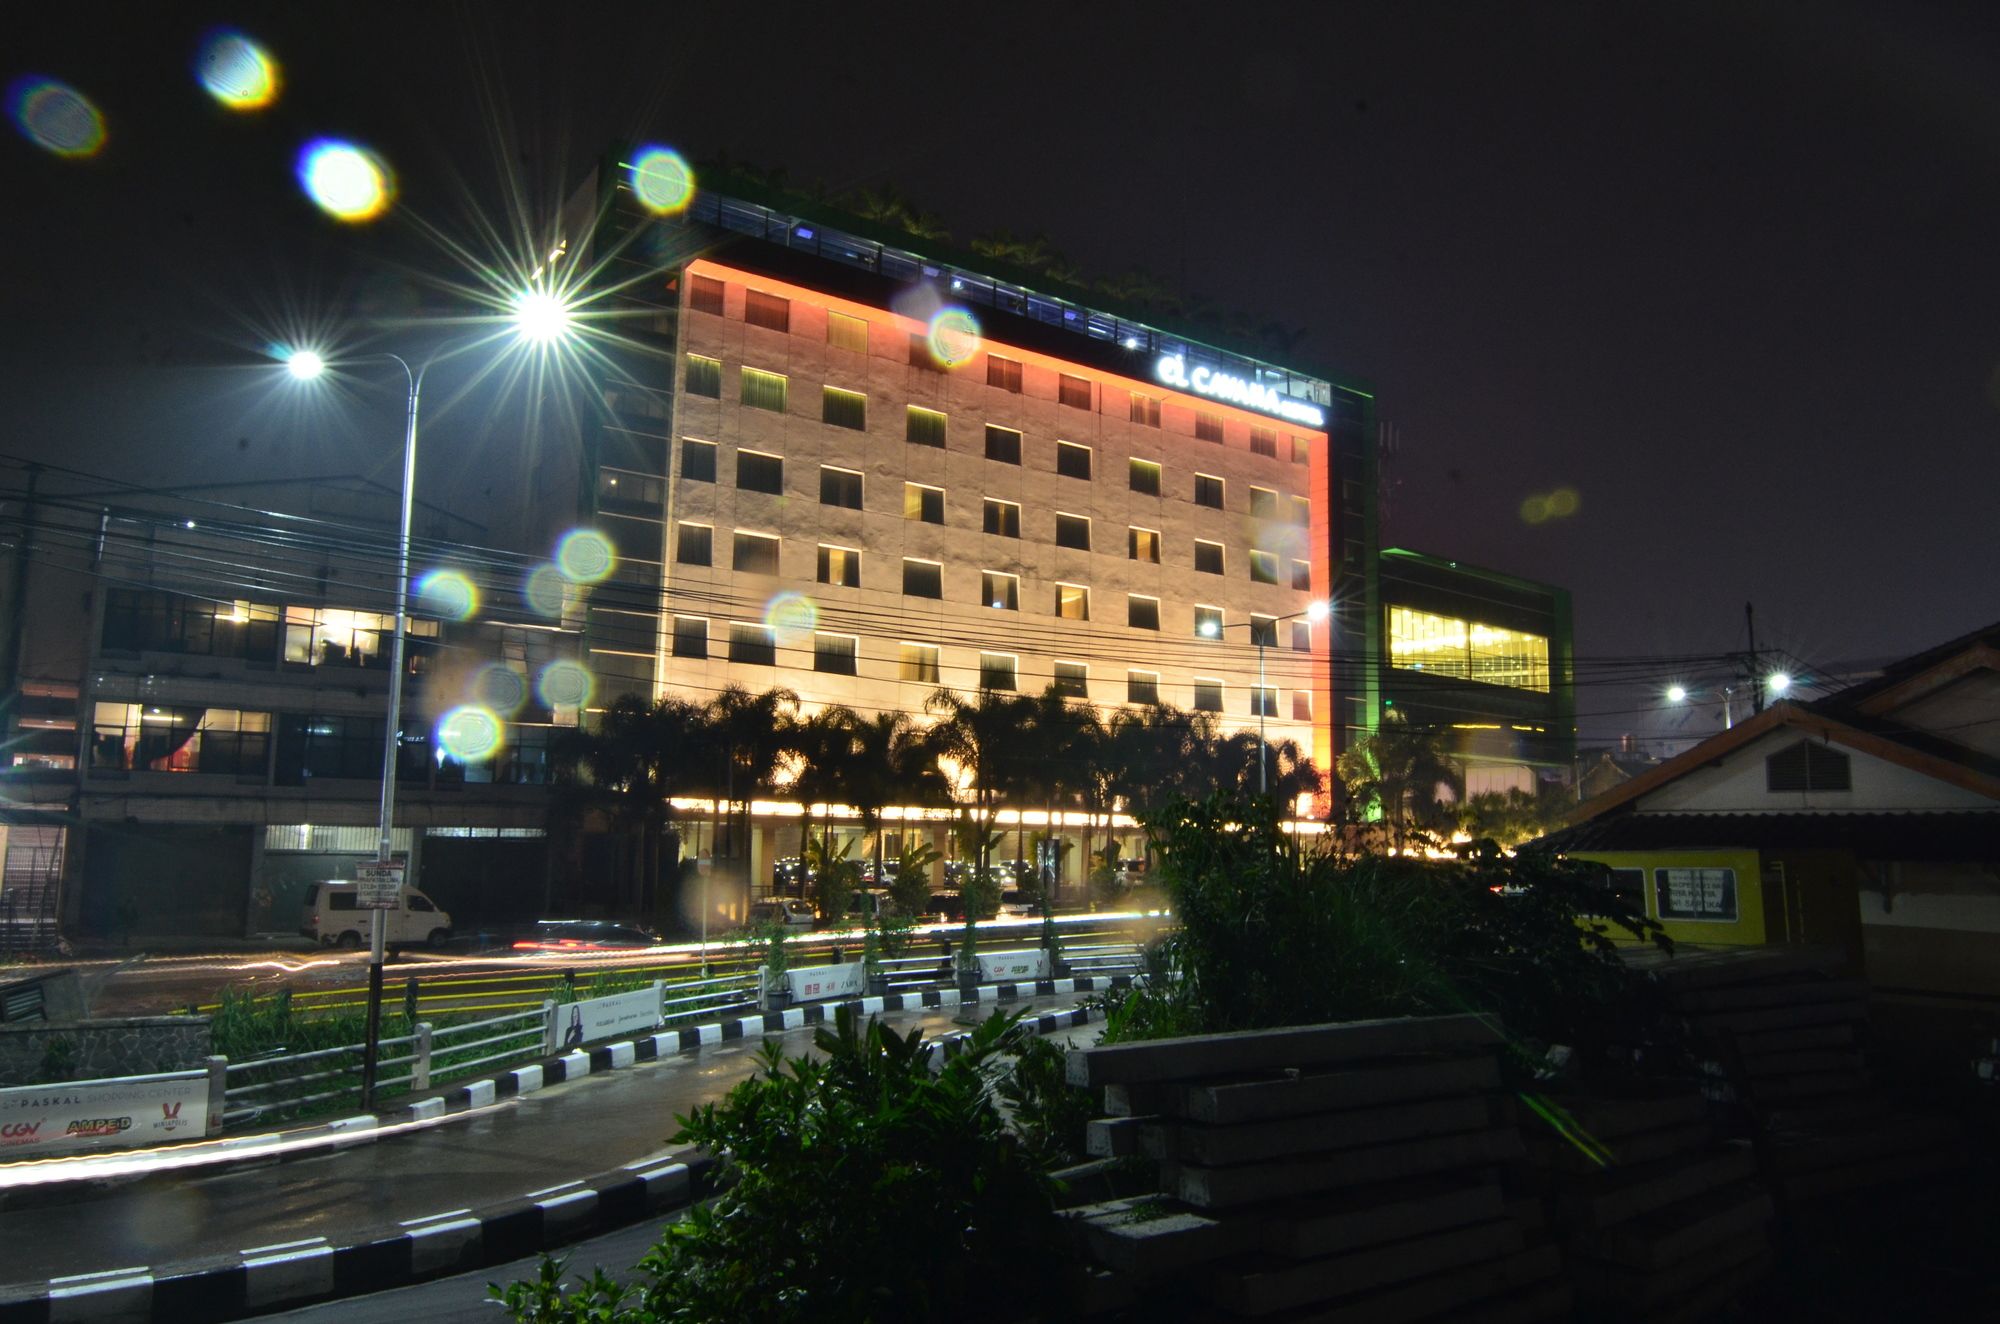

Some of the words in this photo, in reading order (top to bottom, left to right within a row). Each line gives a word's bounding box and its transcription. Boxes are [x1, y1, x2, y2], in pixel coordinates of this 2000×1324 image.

[21, 1097, 80, 1108] PASKAL
[87, 1092, 145, 1103] SHOPPING
[148, 1087, 191, 1098] CENTER
[1, 1121, 41, 1137] CGV
[66, 1117, 132, 1135] AMPED
